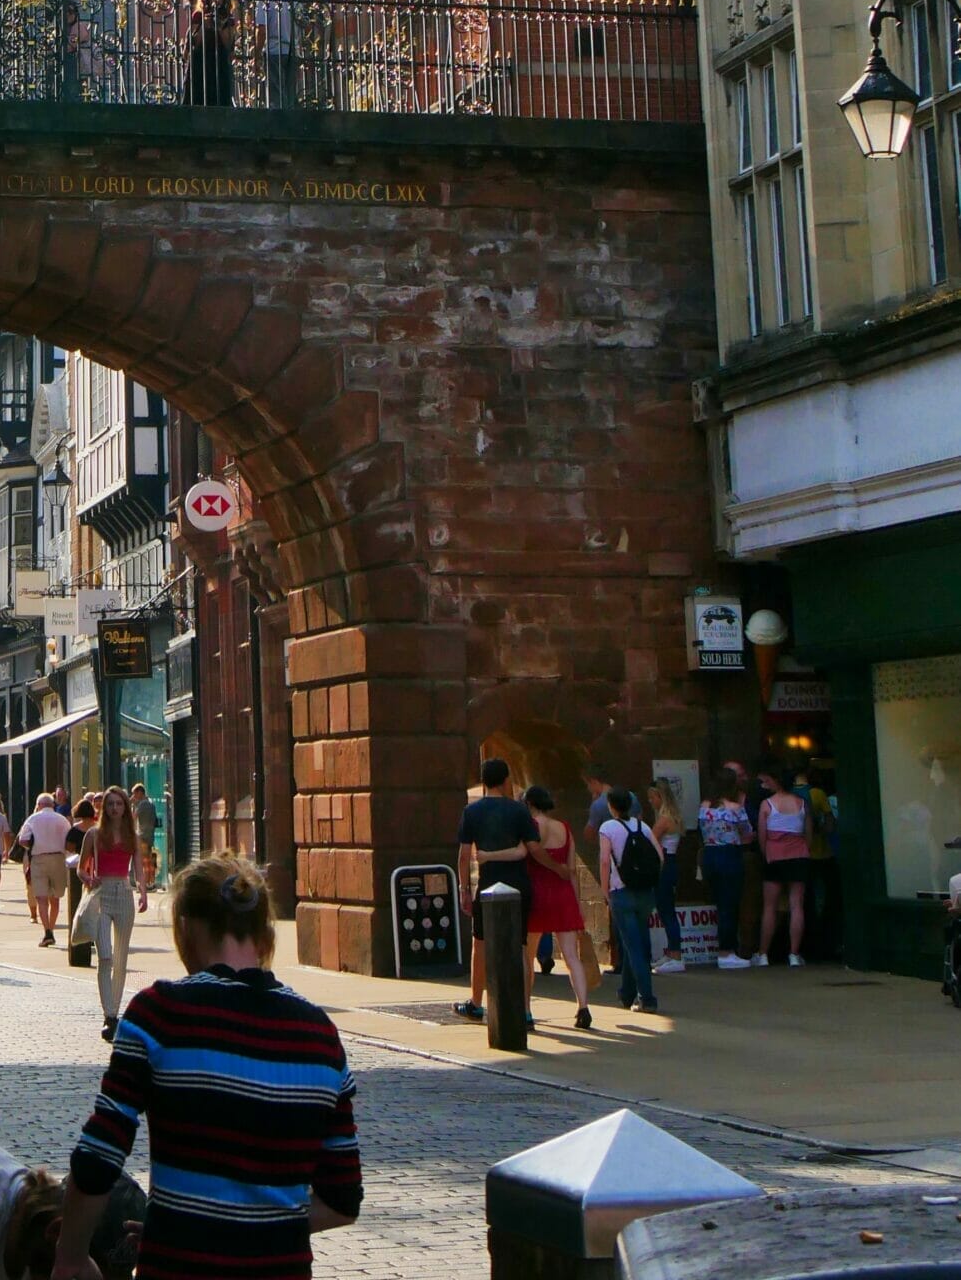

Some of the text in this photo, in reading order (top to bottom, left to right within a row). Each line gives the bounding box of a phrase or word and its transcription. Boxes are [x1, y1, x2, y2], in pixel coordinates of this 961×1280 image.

[83, 176, 135, 194] LORD
[147, 177, 269, 197] GROSVENOR
[701, 653, 743, 665] SOLD HERE
[691, 946, 706, 954] You
